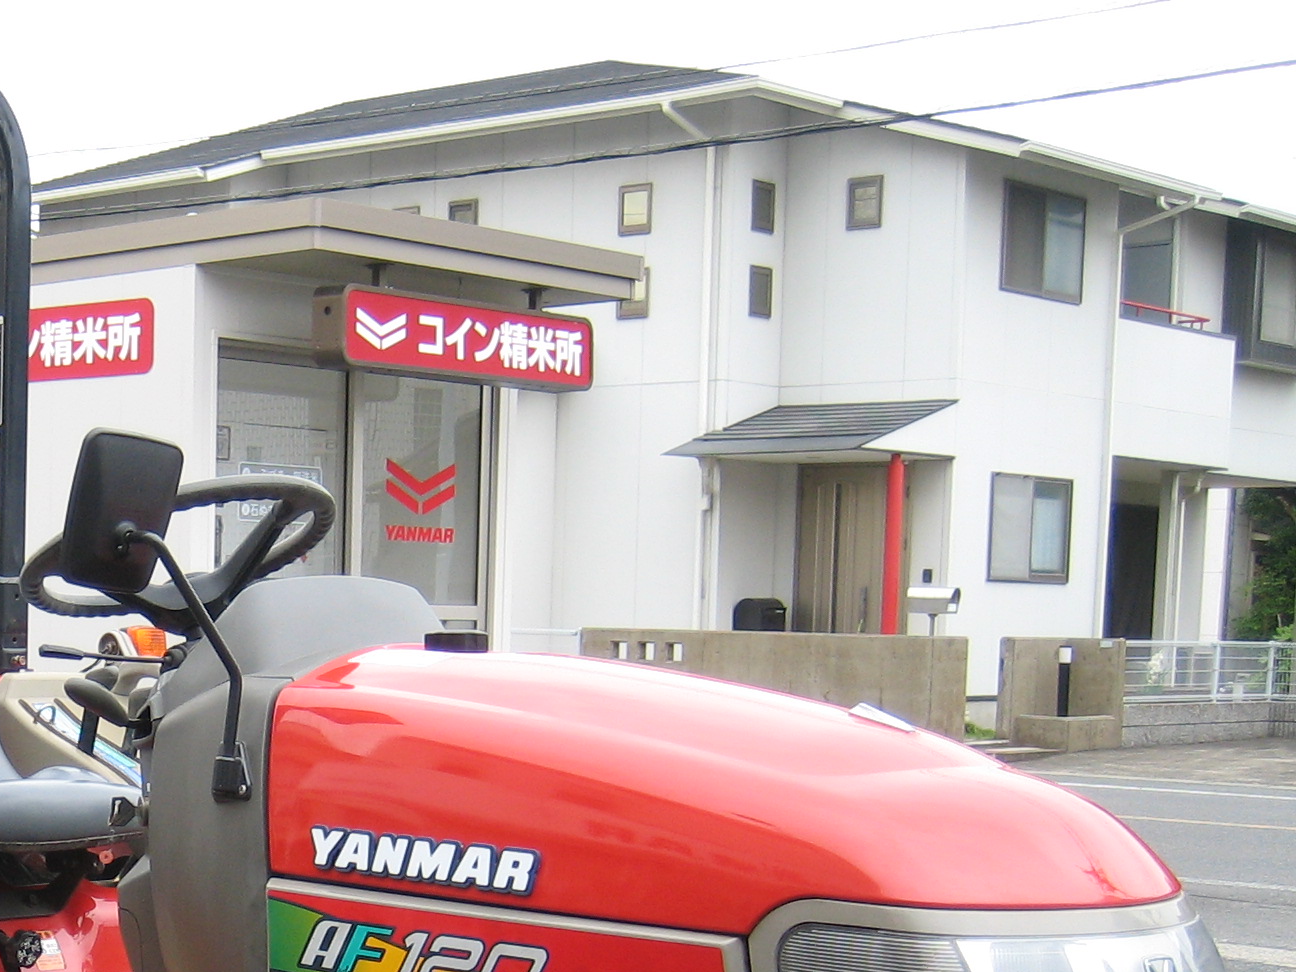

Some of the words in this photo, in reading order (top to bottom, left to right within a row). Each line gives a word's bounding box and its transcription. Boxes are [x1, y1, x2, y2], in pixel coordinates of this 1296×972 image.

[417, 313, 582, 377] コイン精米所
[385, 524, 455, 544] YANMAR
[310, 825, 539, 894] YANMAR
